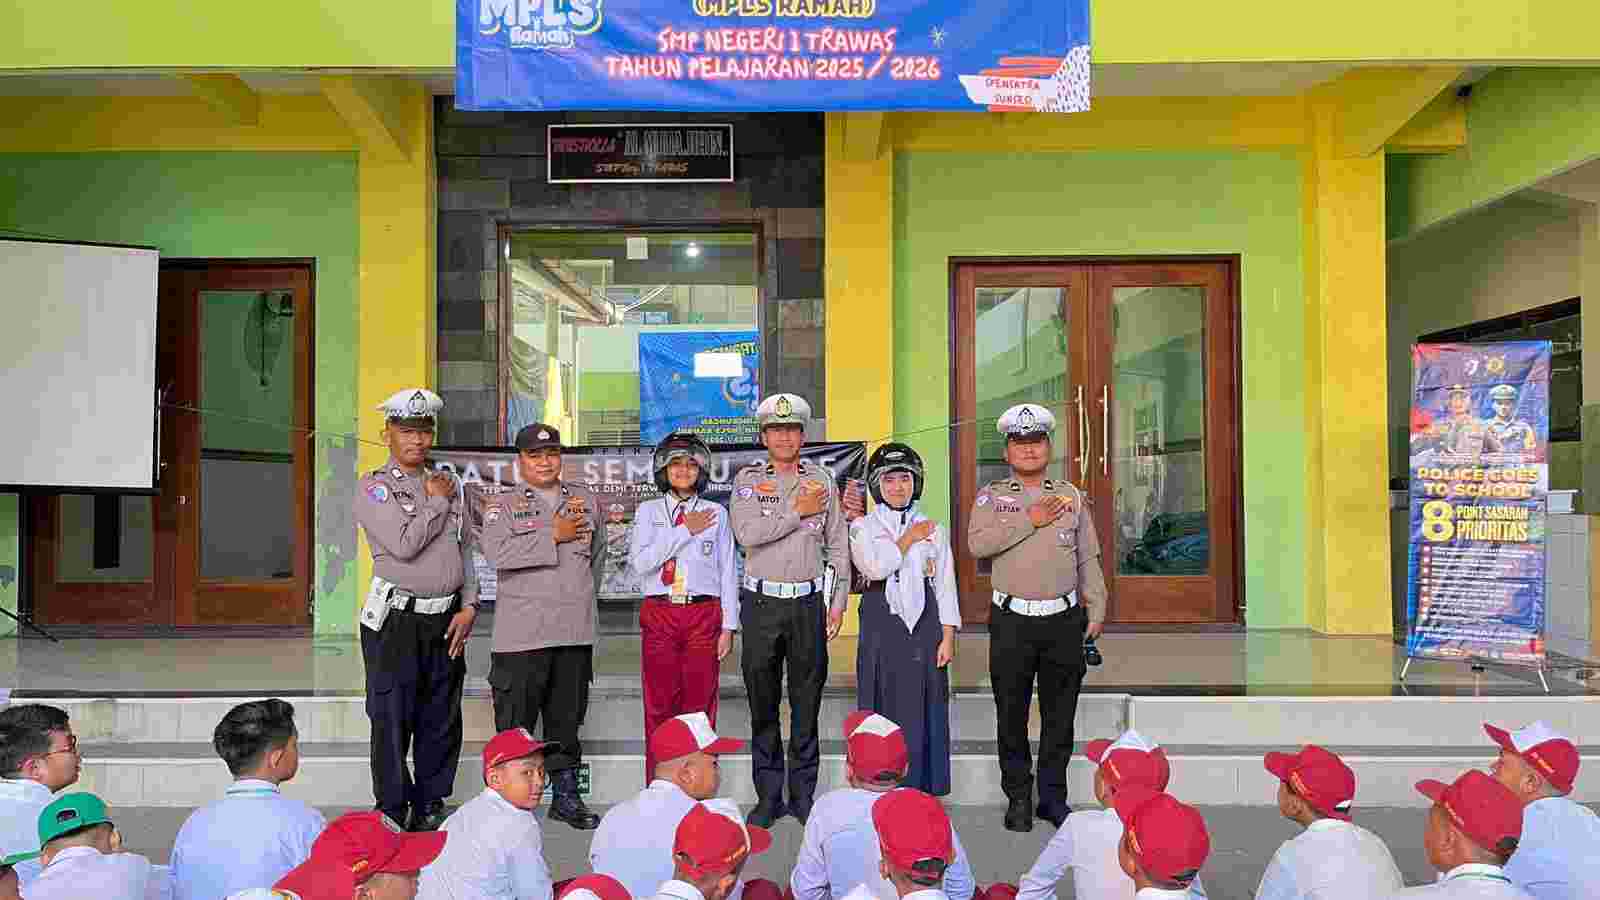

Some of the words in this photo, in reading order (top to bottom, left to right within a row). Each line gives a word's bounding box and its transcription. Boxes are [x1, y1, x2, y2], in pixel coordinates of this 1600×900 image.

[658, 28, 698, 52] SMP
[704, 26, 784, 53] NEGERI
[804, 27, 896, 52] TRAWAS
[606, 57, 681, 78] TAHUN
[688, 55, 808, 79] PELAJARAN
[1417, 467, 1484, 480] POLICE
[1488, 468, 1538, 481] GOES
[1425, 483, 1449, 495] TO
[1455, 483, 1532, 496] SCHOOL
[1423, 501, 1455, 541] 8
[1456, 521, 1528, 542] PRIORITAS
